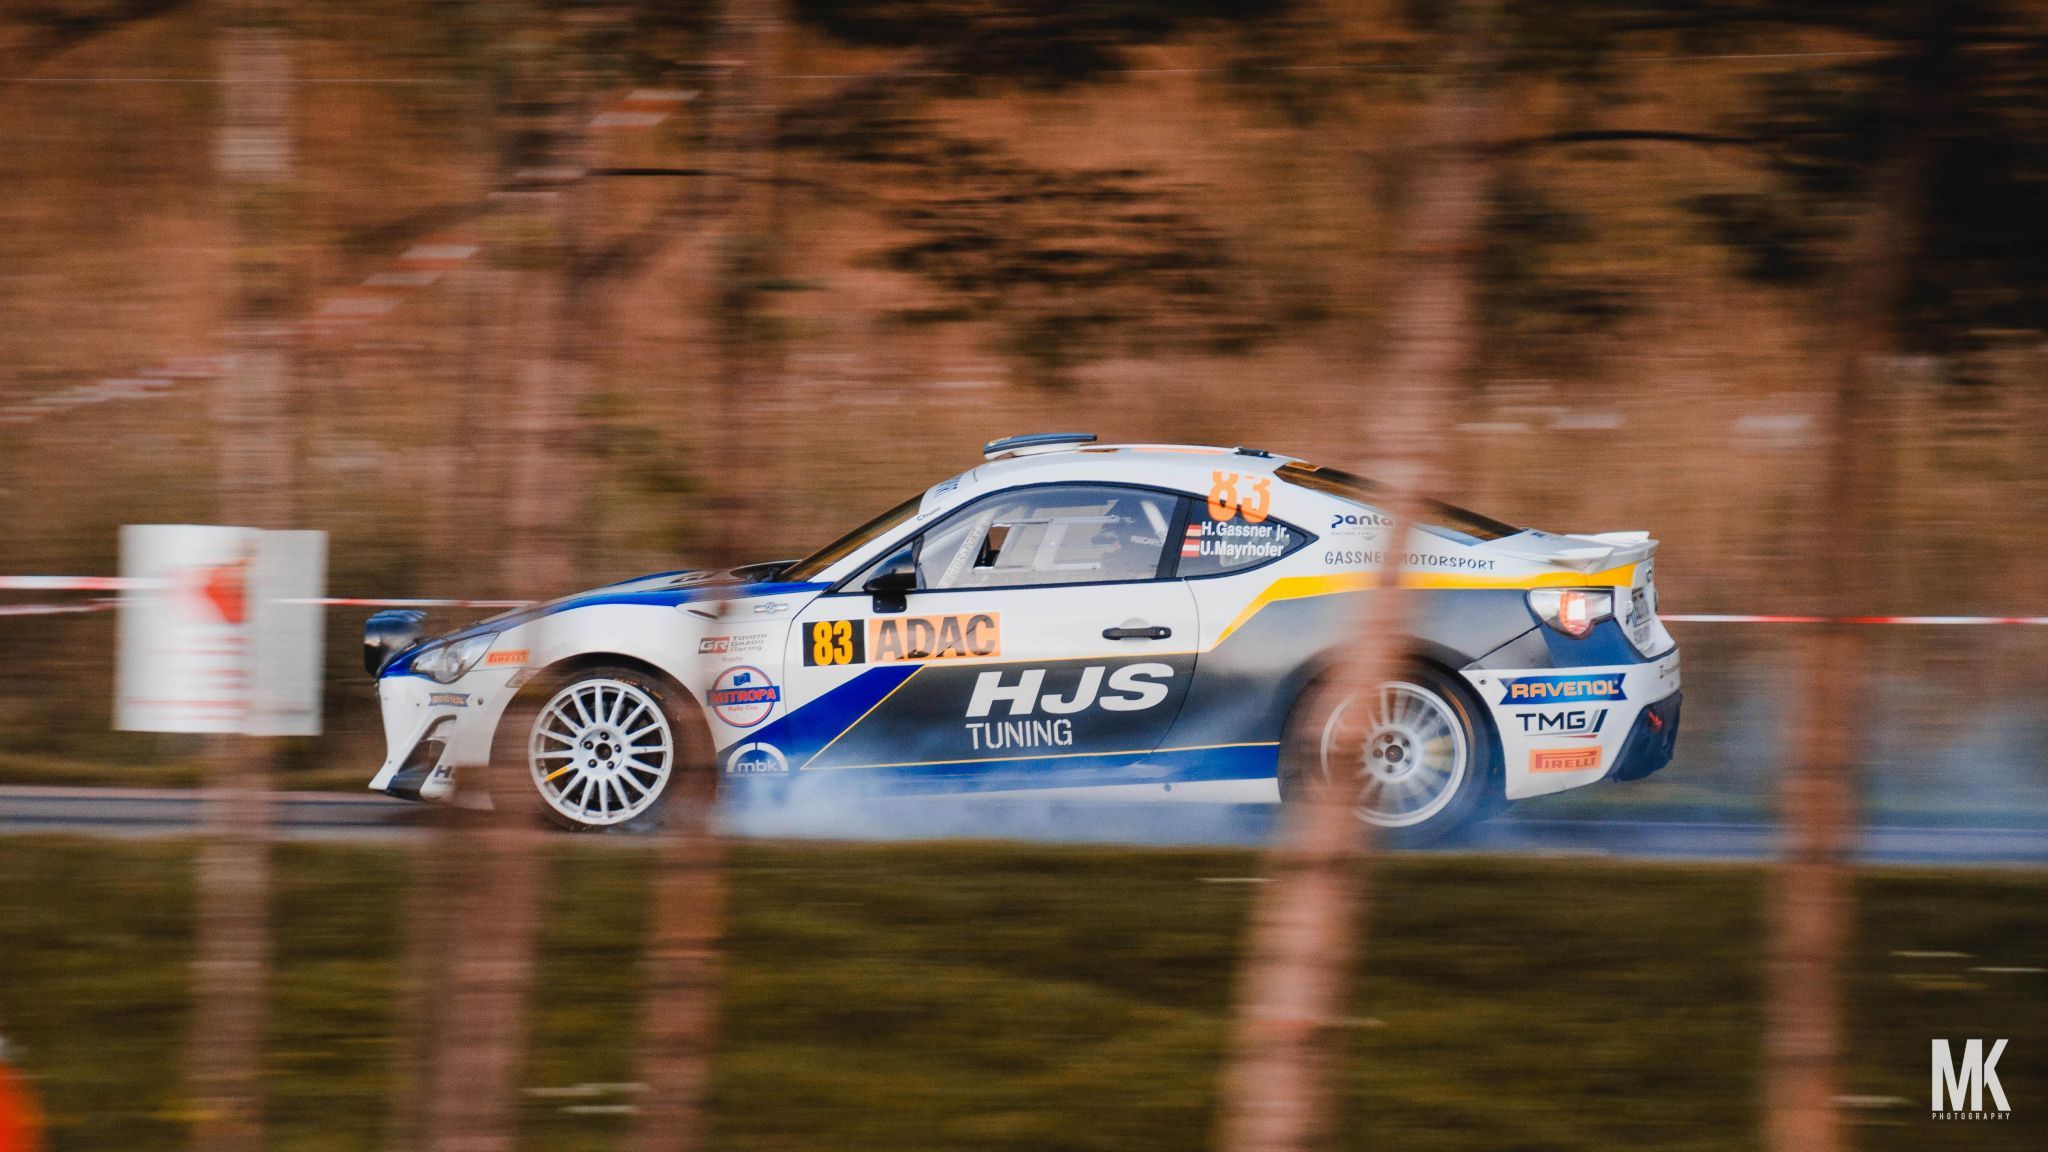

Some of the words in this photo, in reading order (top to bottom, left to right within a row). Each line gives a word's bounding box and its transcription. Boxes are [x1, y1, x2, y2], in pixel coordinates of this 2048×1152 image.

[1207, 470, 1271, 523] 83
[1201, 521, 1273, 538] H.Gassner
[1276, 524, 1290, 541] jr.
[1331, 514, 1393, 529] panta
[1200, 540, 1285, 560] U.Mayrhofer
[699, 639, 728, 652] GR
[813, 620, 854, 667] 83
[875, 614, 996, 661] ADAC
[710, 688, 777, 704] MITROPA
[965, 662, 1175, 718] HJS
[1511, 680, 1619, 699] RAVENOL
[1516, 711, 1586, 731] TMG
[965, 719, 1073, 750] TUNING
[737, 759, 778, 772] mbk
[1535, 750, 1598, 769] PIRELLI
